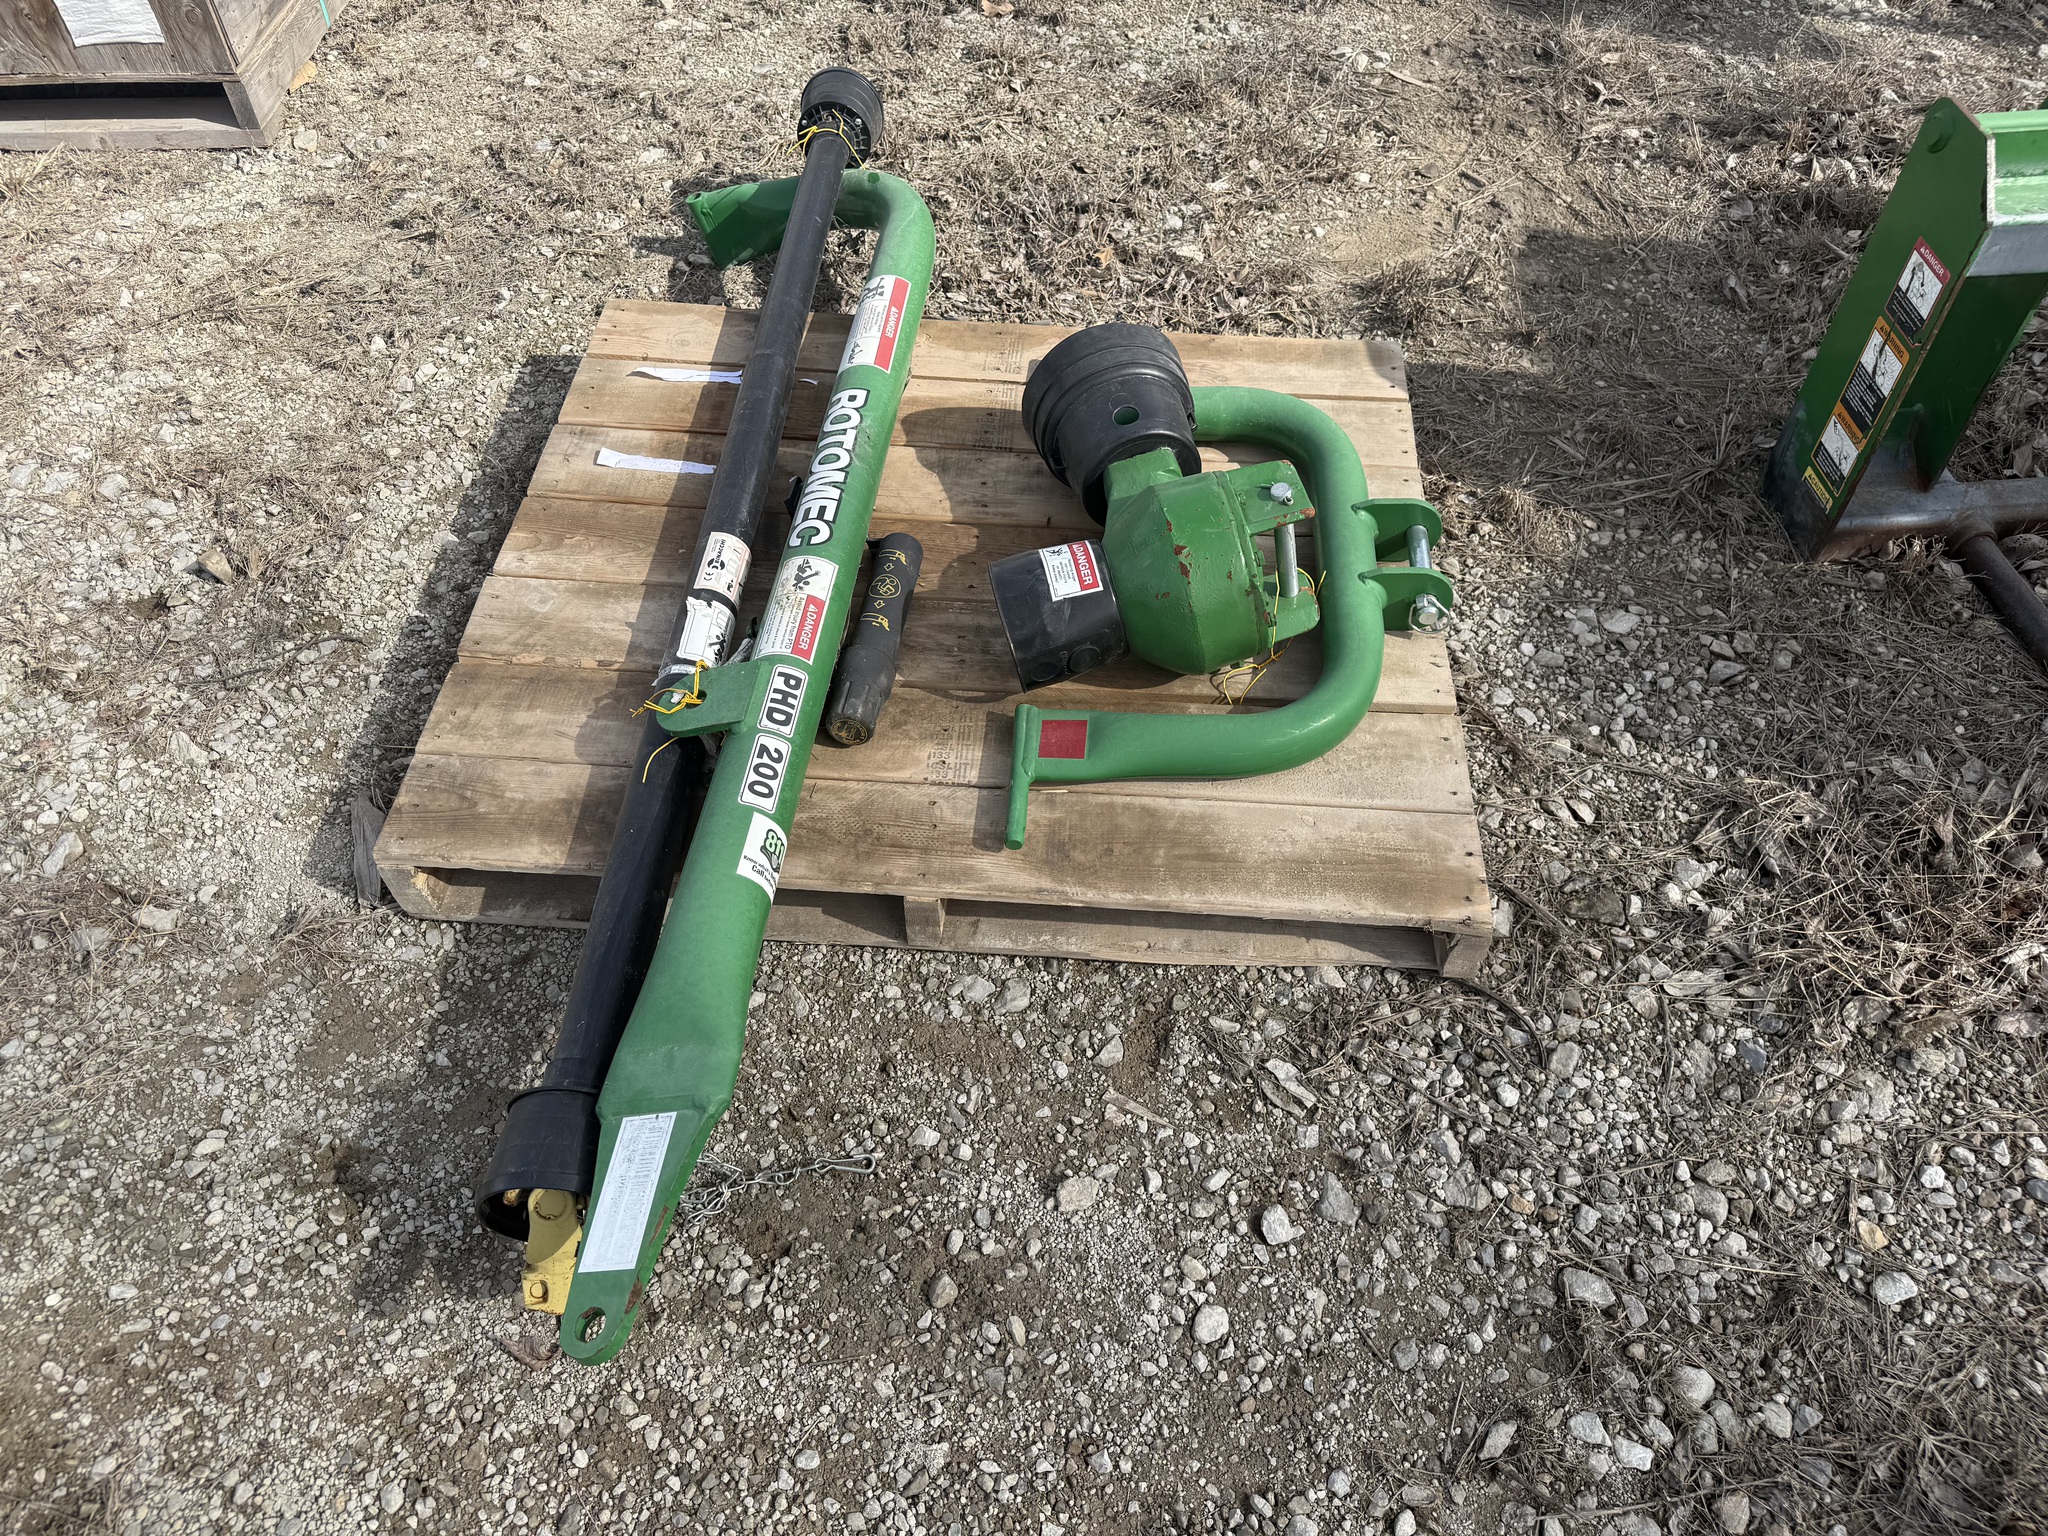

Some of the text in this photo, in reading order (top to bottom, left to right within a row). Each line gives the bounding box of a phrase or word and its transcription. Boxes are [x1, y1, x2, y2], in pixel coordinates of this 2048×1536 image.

[1924, 250, 1945, 276] DANGER
[884, 311, 897, 338] DANGER
[788, 388, 869, 547] ROTOMEC
[1074, 547, 1093, 584] DANGER
[795, 596, 804, 611] Avoid
[787, 624, 796, 638] from
[790, 610, 800, 625] injury
[798, 611, 815, 650] DANGER
[784, 637, 793, 649] PTO
[765, 671, 802, 727] PHD
[748, 743, 784, 798] 200
[765, 830, 785, 863] 811
[751, 864, 764, 877] Call
